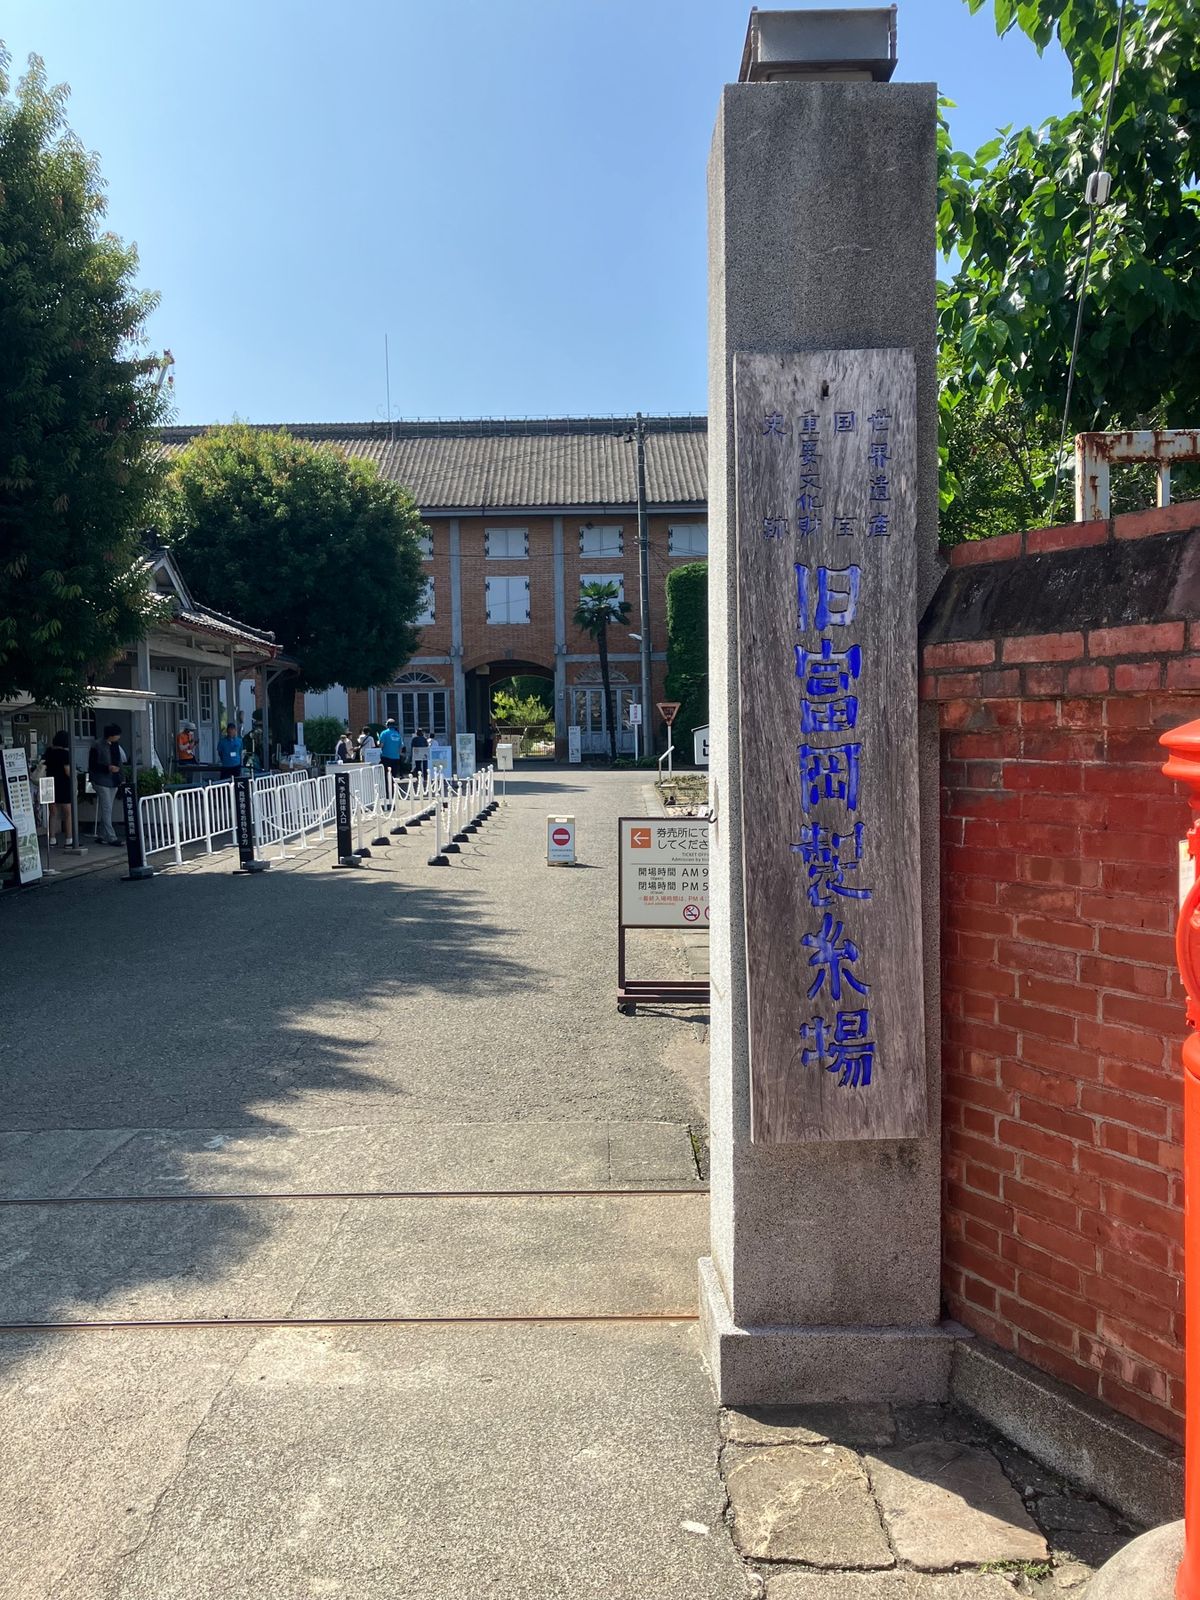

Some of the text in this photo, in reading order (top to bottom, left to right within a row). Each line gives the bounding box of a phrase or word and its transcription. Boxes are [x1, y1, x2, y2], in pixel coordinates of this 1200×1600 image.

[796, 409, 825, 538] 重要文化財
[833, 410, 858, 538] 国宝
[867, 408, 893, 538] 世界遺産
[638, 867, 677, 877] 開場時間
[681, 868, 699, 877] AM
[638, 881, 677, 891] 閉場時間
[681, 882, 699, 891] PM
[657, 827, 709, 838] 券売所にて
[792, 562, 877, 1089] 旧富岡製糸場
